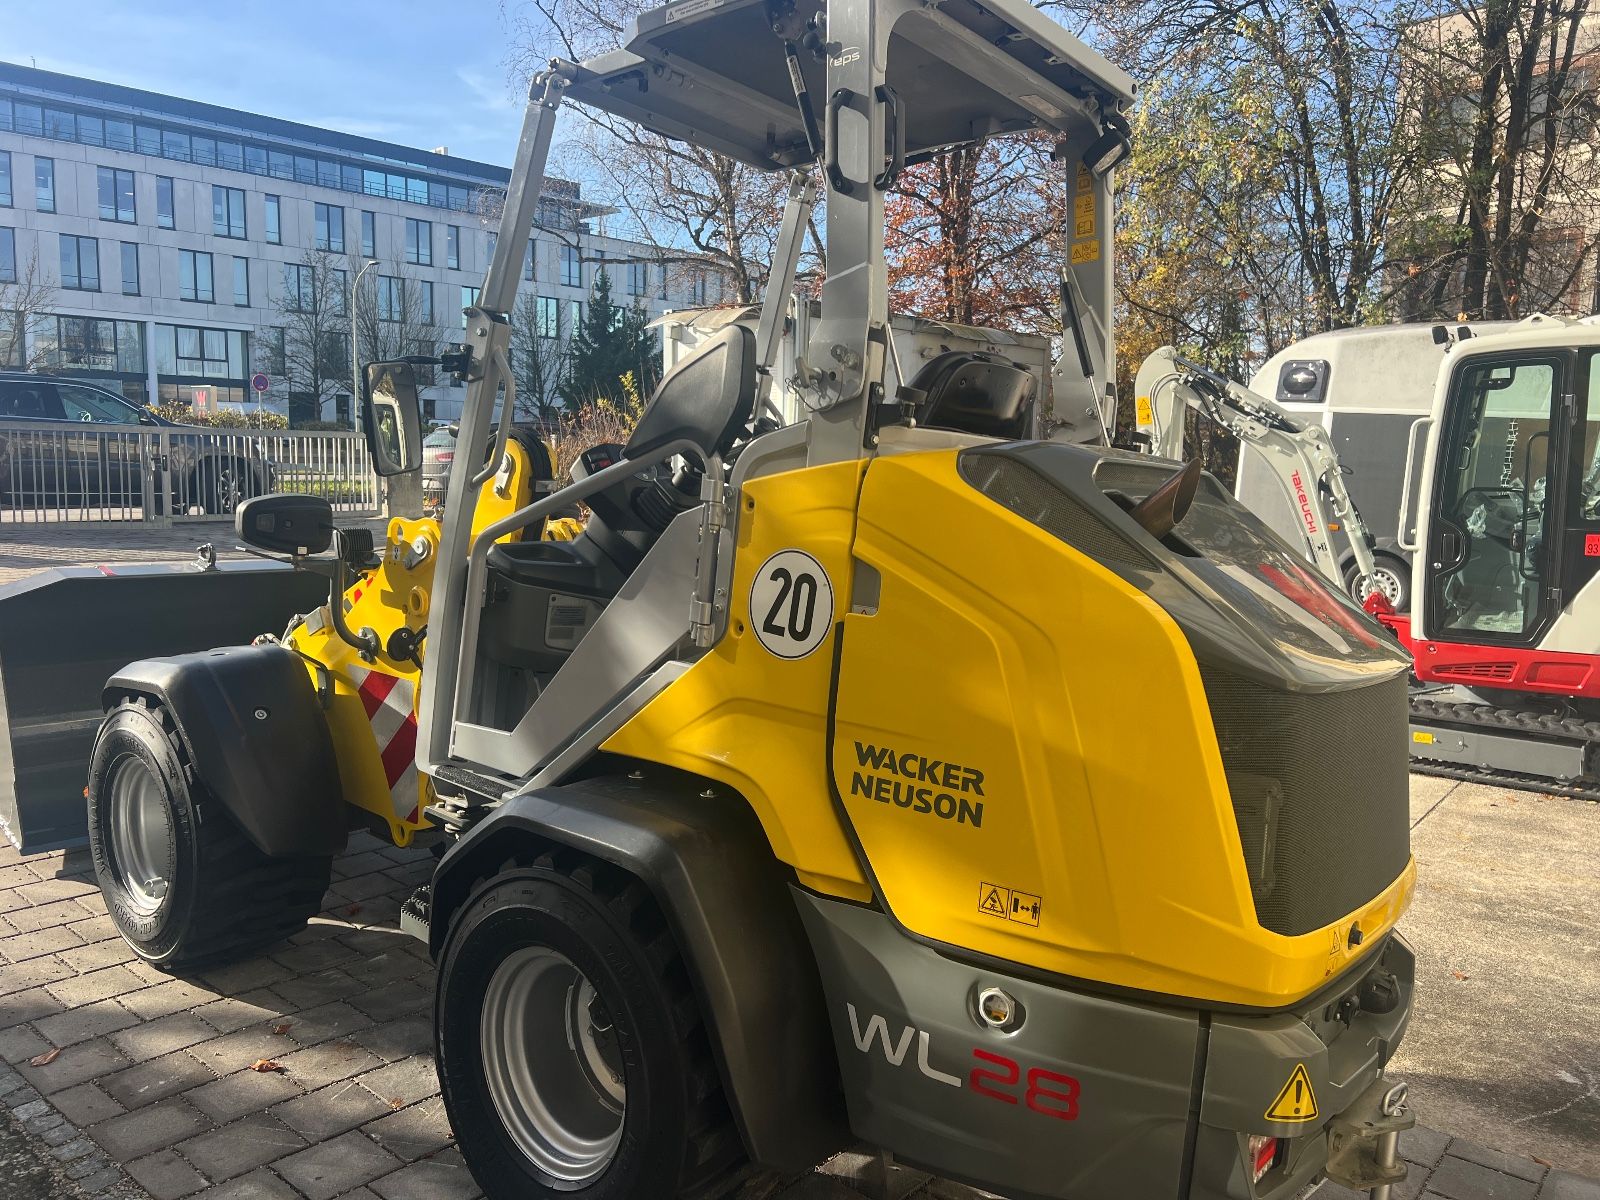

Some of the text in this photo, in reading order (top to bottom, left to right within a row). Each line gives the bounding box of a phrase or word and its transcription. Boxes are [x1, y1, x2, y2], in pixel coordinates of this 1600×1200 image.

[1291, 469, 1317, 534] TAKEUCHI
[762, 567, 818, 642] 20
[854, 741, 985, 796] WACKER
[850, 771, 984, 828] NEUSON
